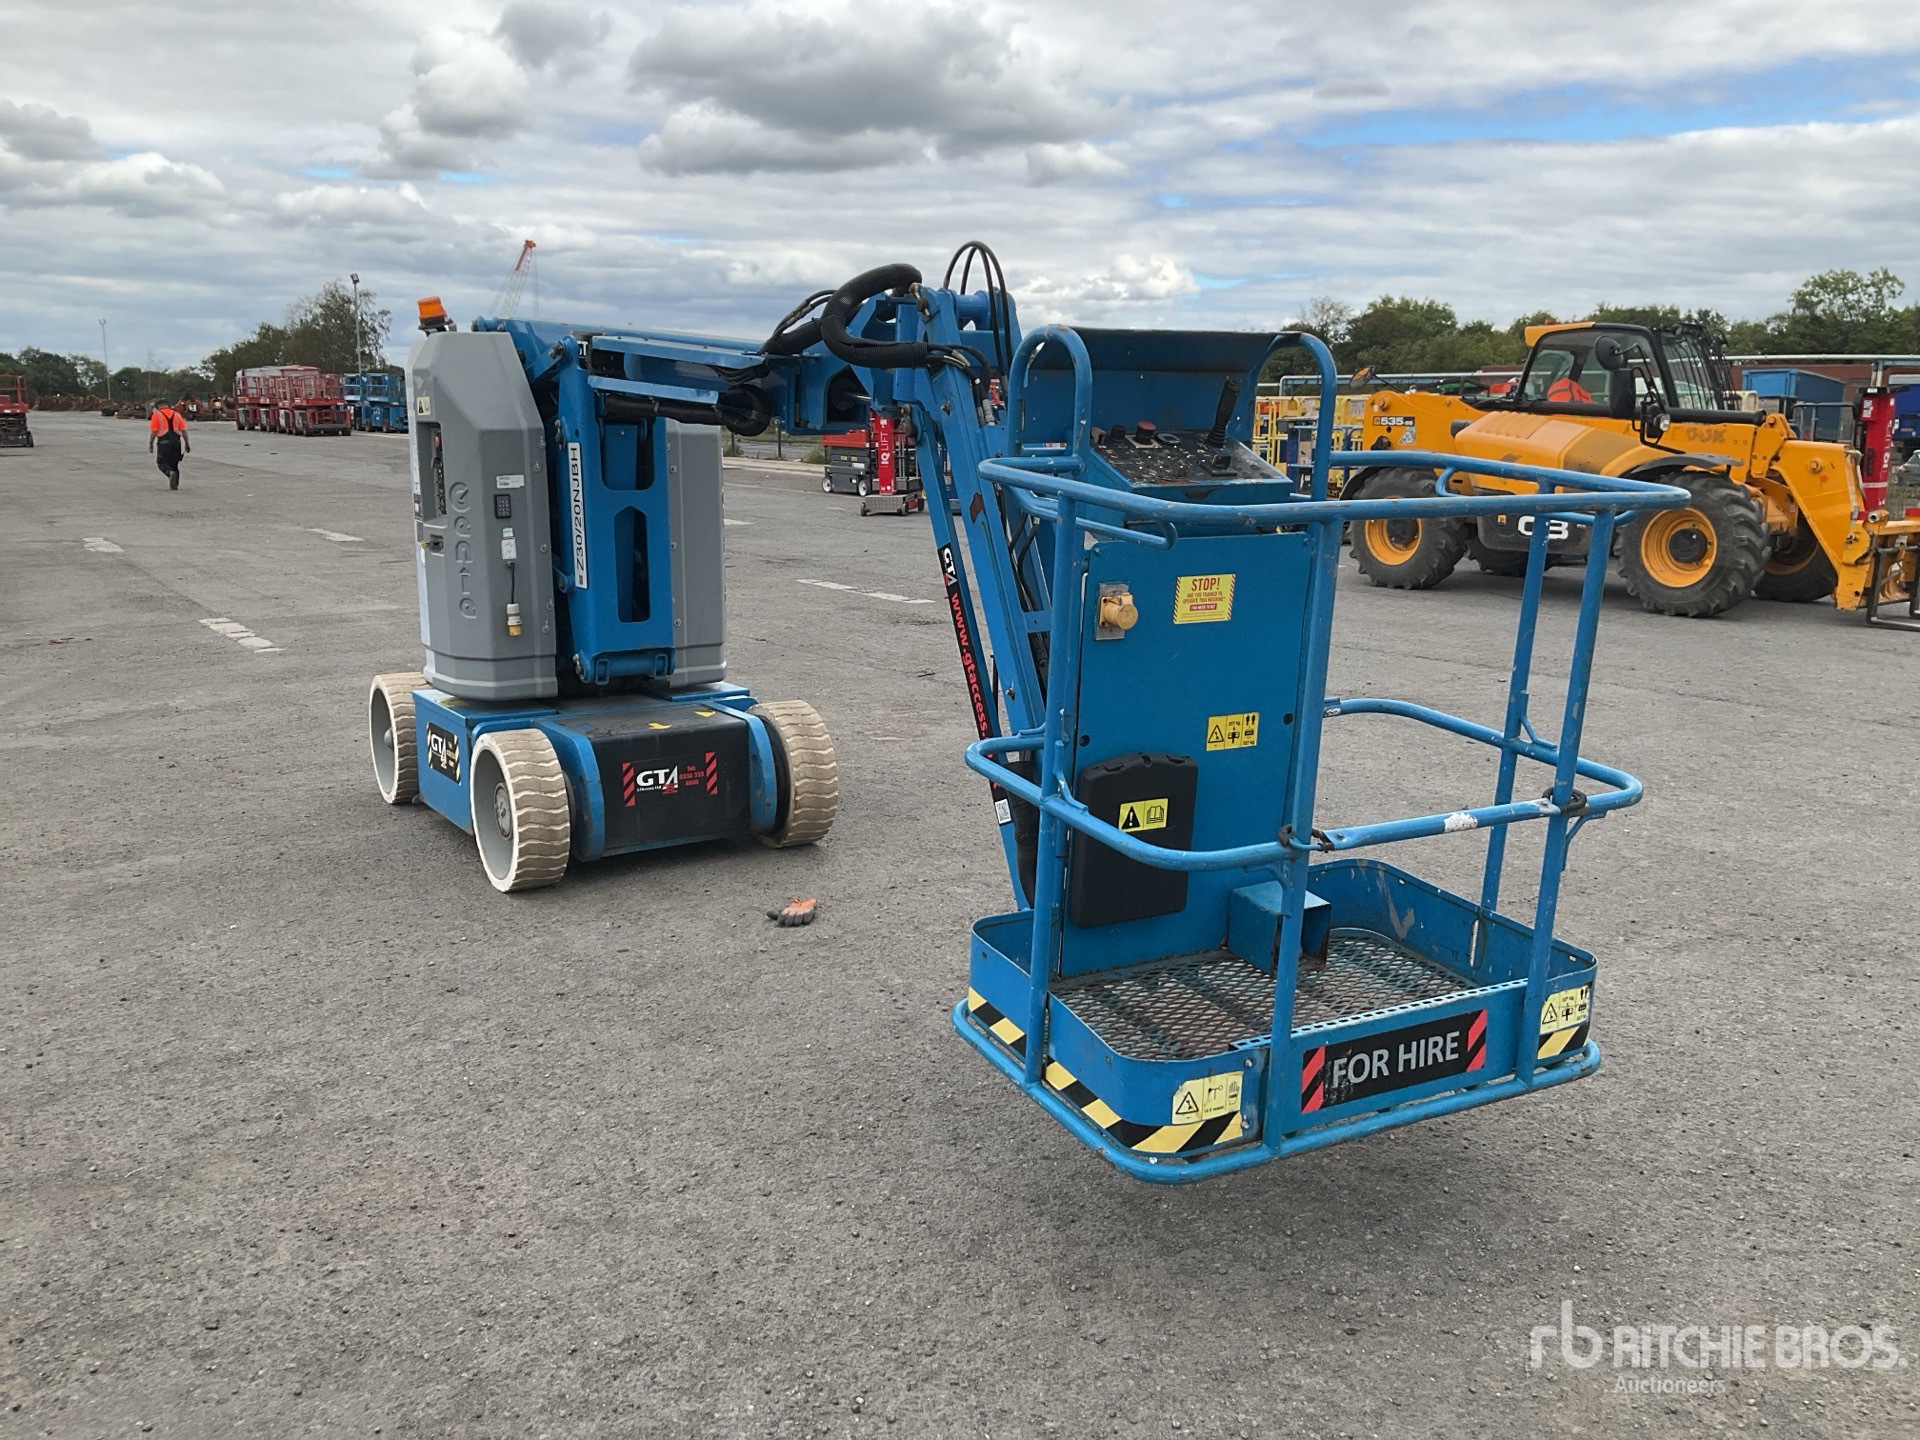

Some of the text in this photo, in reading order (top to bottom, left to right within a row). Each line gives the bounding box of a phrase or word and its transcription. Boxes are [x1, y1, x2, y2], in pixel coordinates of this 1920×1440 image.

[570, 447, 585, 572] Z30/20NJBH
[942, 546, 958, 587] GTA
[1191, 577, 1221, 592] STOP!
[636, 765, 678, 791] GTA
[1331, 1030, 1461, 1089] FOR HIRE
